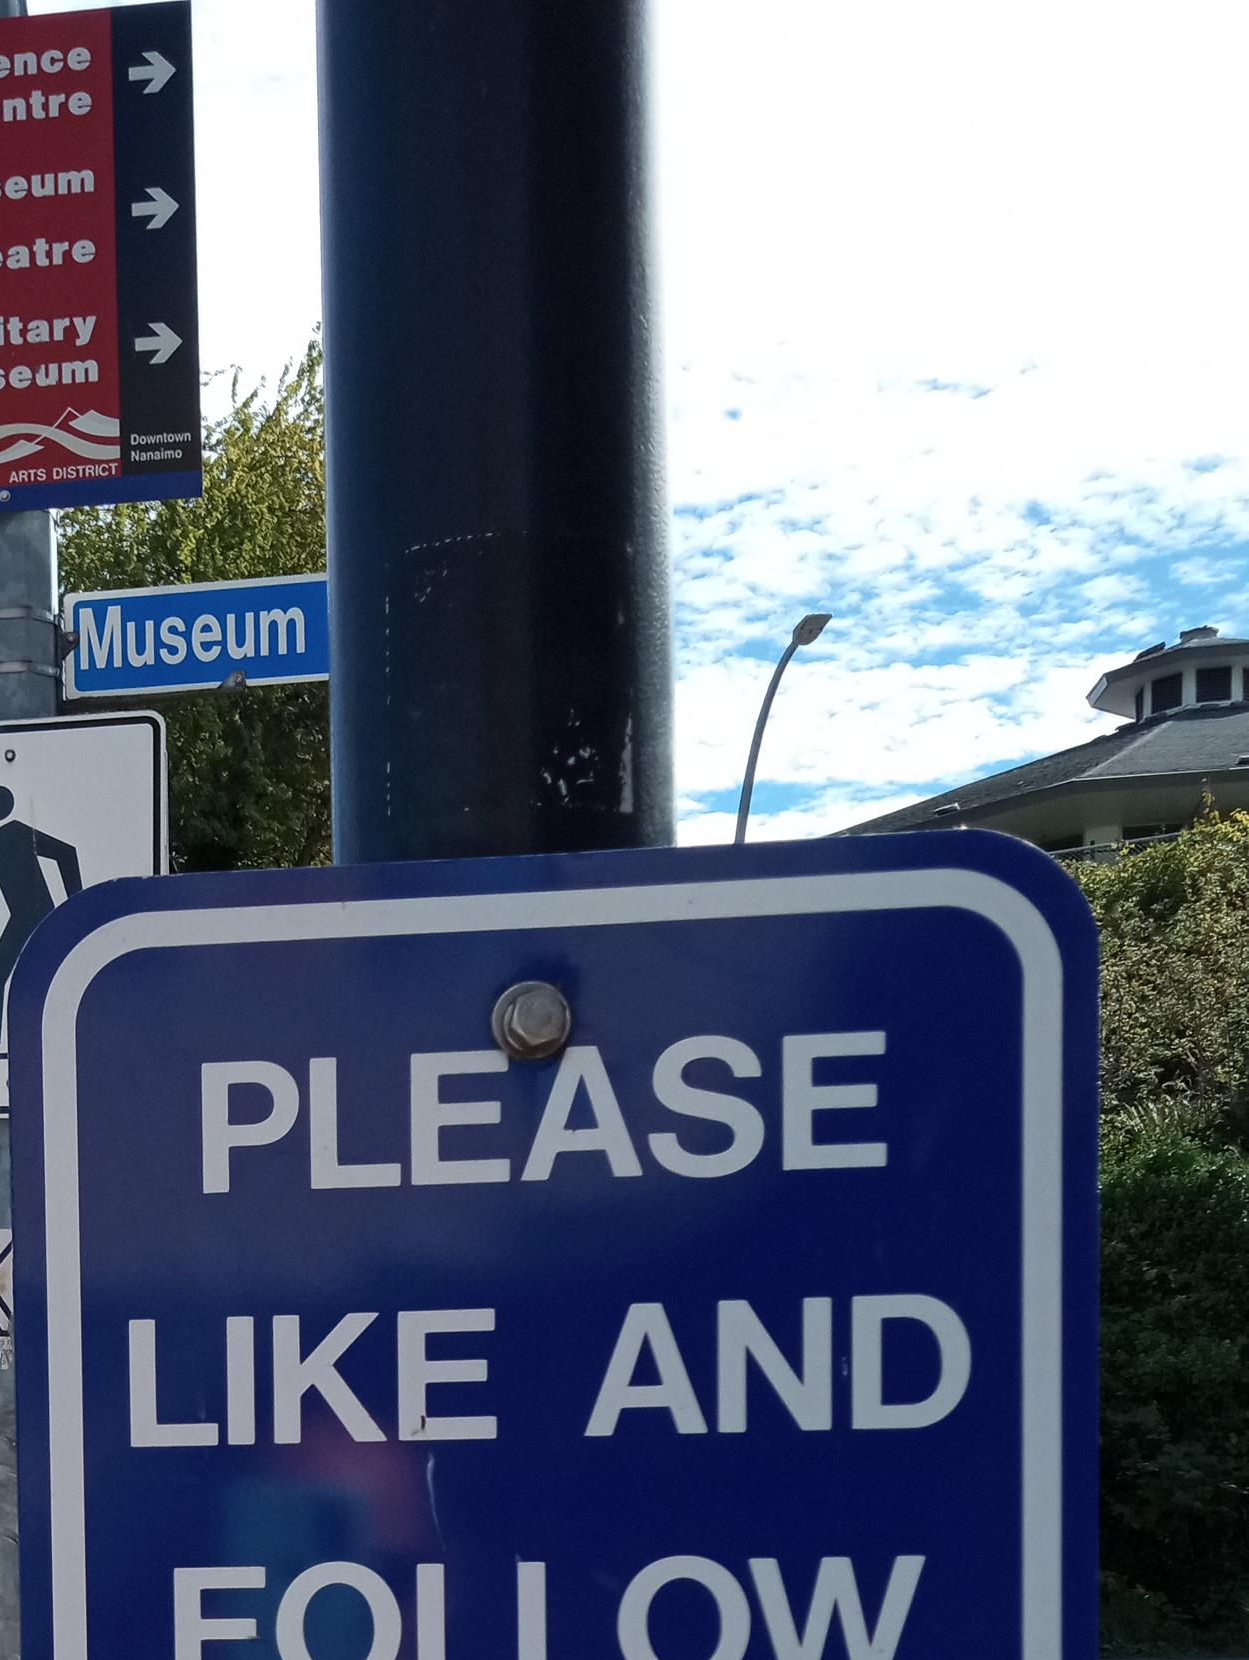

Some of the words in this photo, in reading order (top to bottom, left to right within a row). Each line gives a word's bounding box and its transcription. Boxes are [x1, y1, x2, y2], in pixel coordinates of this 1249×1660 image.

[131, 433, 191, 445] Downtown
[131, 448, 182, 461] Nanaimo
[10, 469, 46, 483] ARTS
[53, 463, 118, 479] DISTRICT
[80, 606, 305, 669] Museum
[202, 1032, 886, 1193] PLEASE
[129, 1309, 496, 1447] LIKE
[585, 1295, 970, 1436] AND
